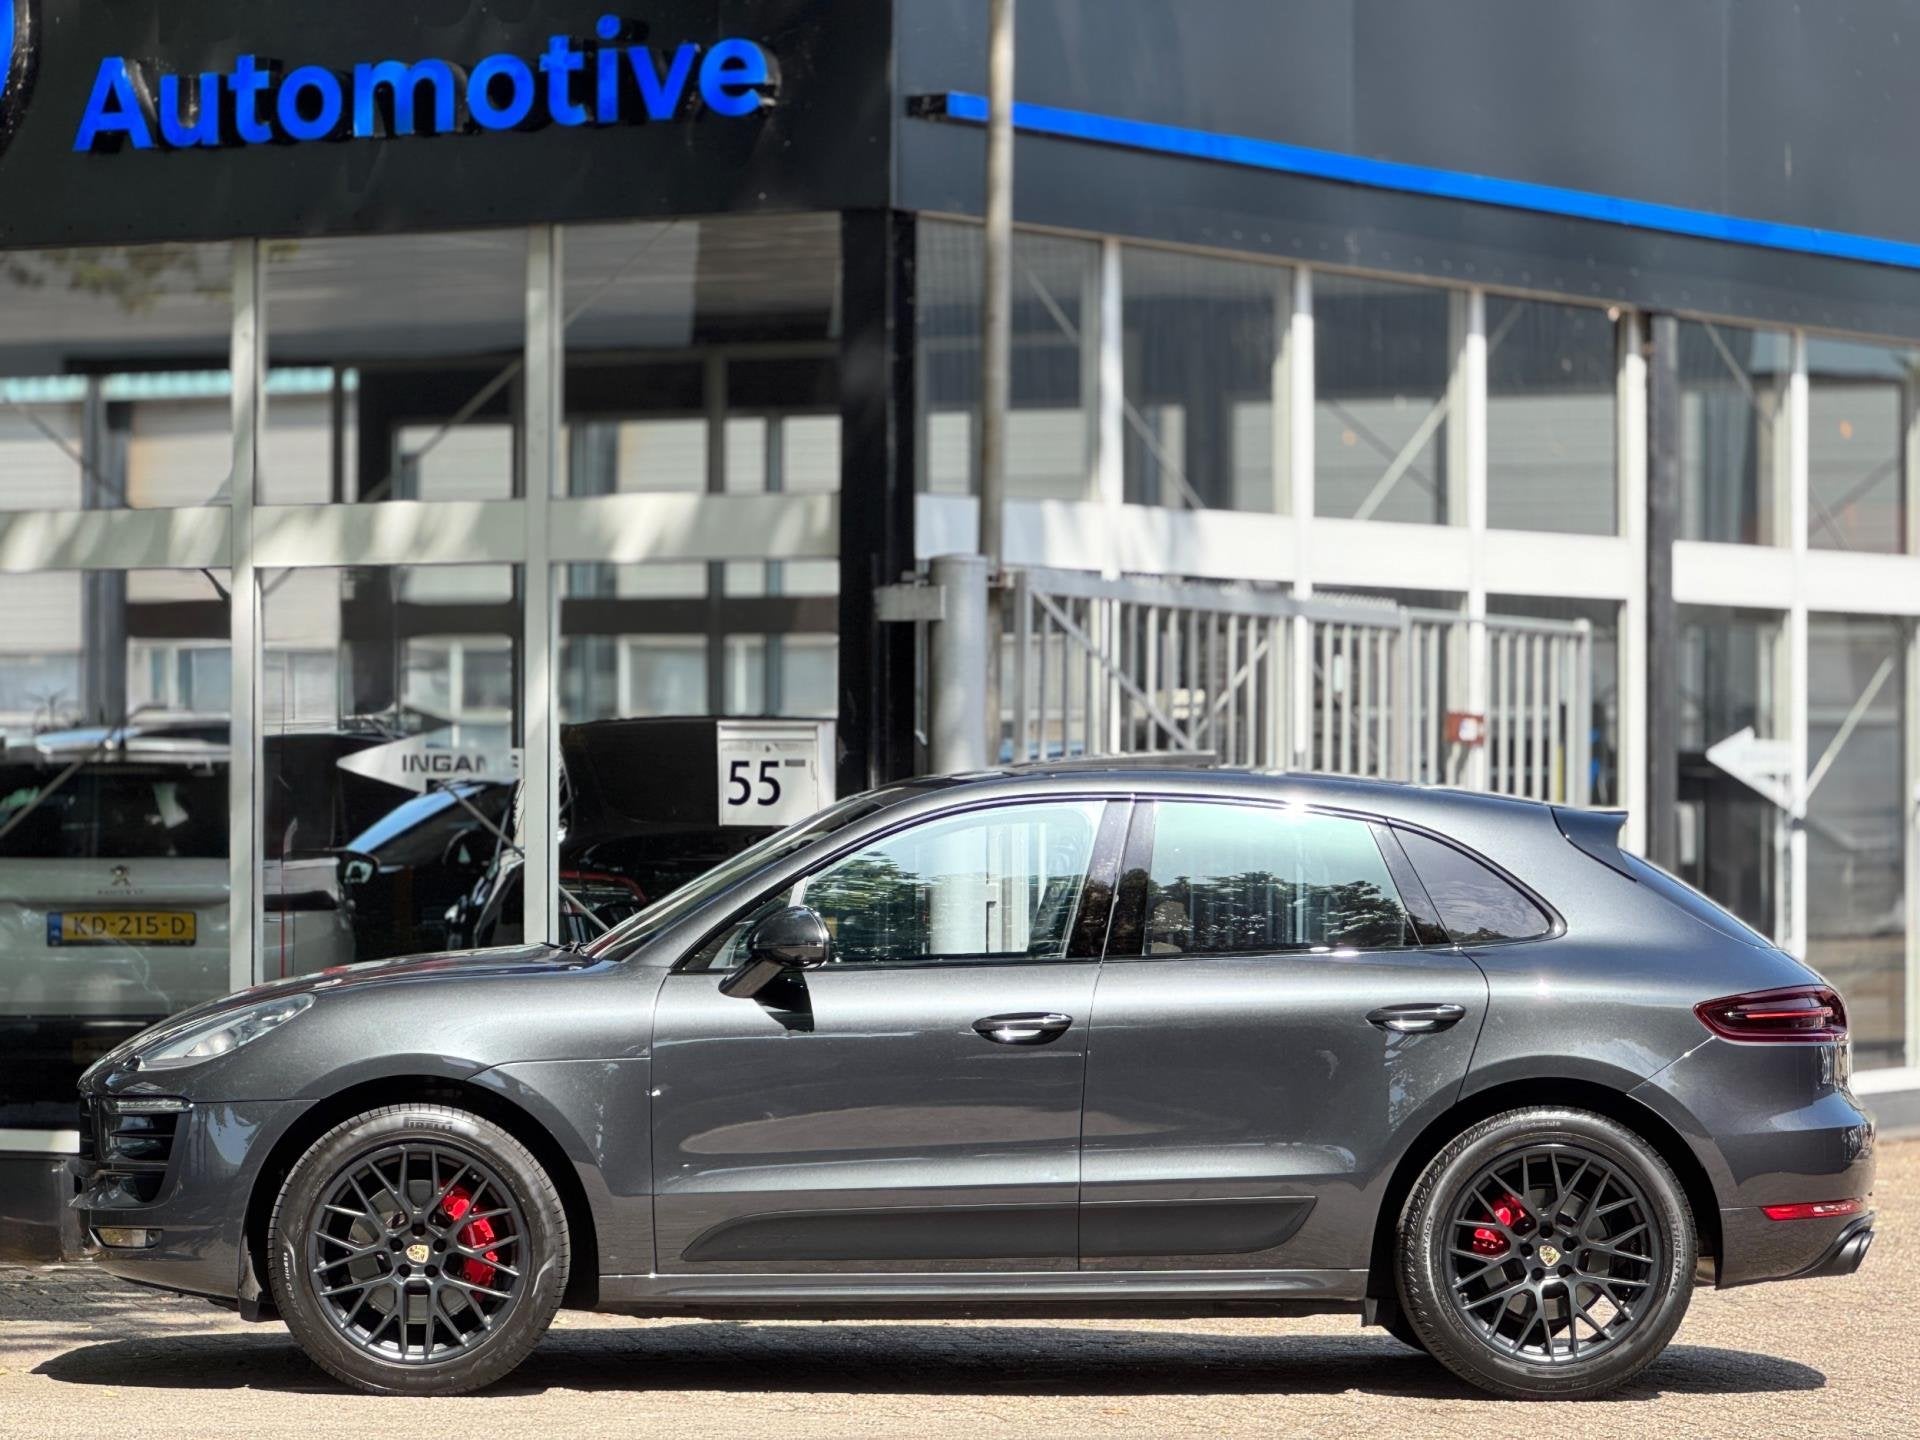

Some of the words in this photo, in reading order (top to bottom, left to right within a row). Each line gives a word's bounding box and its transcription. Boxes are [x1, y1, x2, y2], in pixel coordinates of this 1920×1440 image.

[74, 14, 772, 152] Automotive
[402, 754, 519, 773] INGAN
[727, 760, 781, 806] 55
[73, 916, 186, 936] KD-215-D
